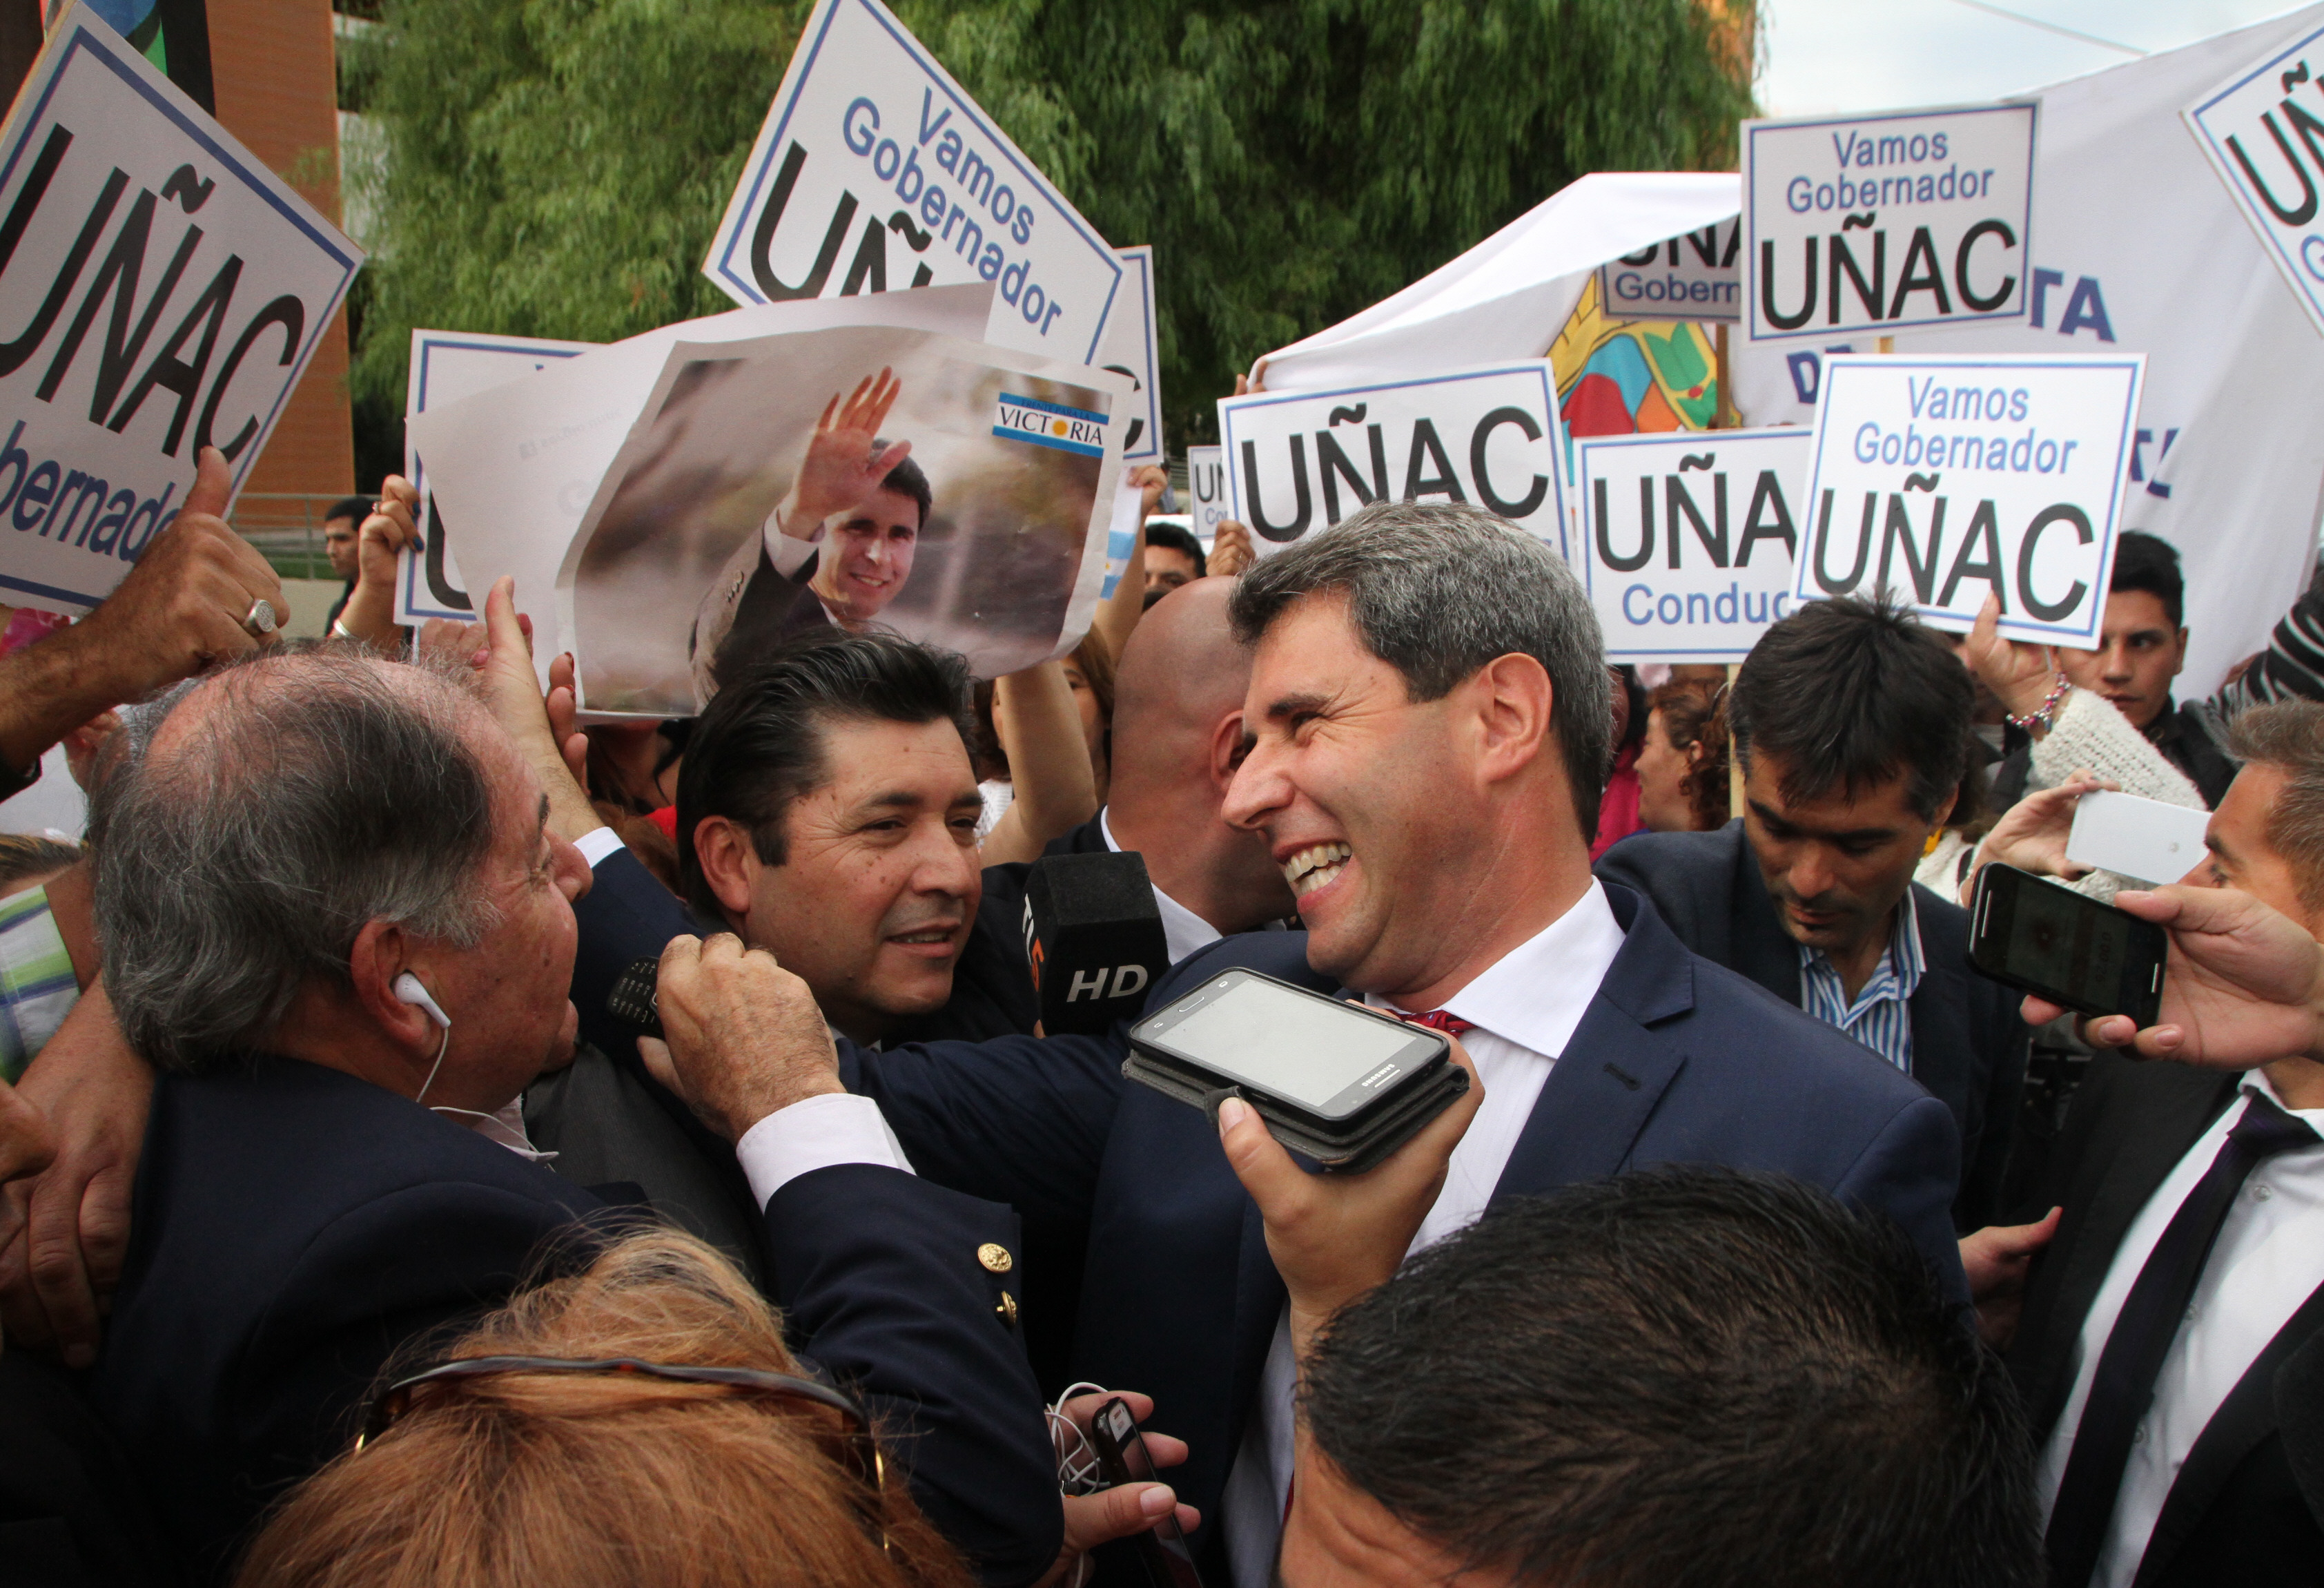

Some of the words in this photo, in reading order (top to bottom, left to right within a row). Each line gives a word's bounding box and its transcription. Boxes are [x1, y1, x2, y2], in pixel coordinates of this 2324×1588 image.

[919, 86, 1034, 244] Vamos
[1788, 164, 1994, 213] Gobernador
[1833, 131, 1949, 167] Vamos
[843, 97, 1062, 336] Gobernador
[1761, 211, 2017, 330] UÑAC
[1854, 422, 2077, 474] Gobernador
[1908, 376, 2029, 421] Vamos
[1241, 403, 1549, 542] UÑAC
[1593, 452, 1797, 572] UÑA
[1813, 472, 2094, 621] UÑAC
[1066, 965, 1148, 1002] HD
